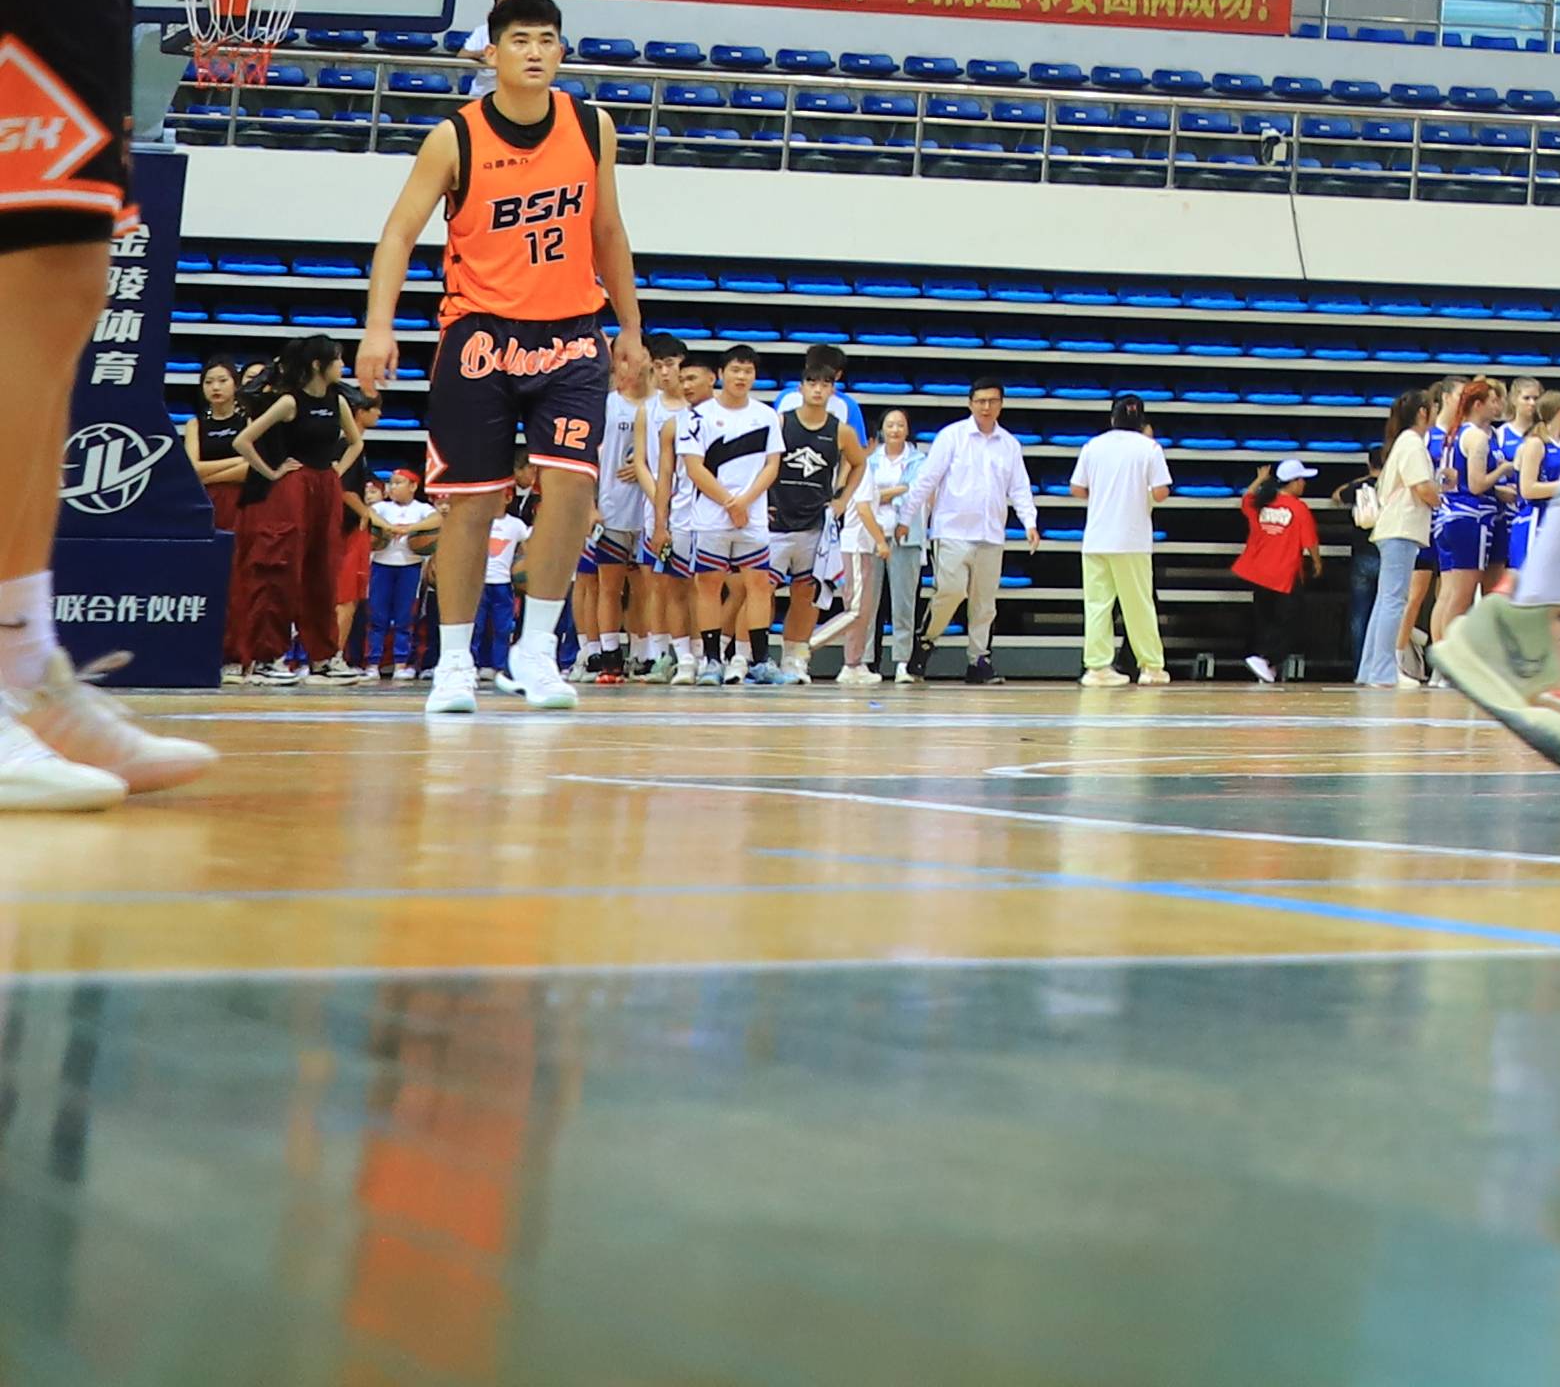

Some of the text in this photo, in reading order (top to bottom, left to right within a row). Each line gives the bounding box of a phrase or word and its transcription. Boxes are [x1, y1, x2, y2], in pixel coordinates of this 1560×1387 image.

[0, 116, 69, 153] SK
[488, 181, 587, 232] BSK
[523, 225, 566, 267] 12
[90, 223, 150, 385] 金陵体育
[552, 417, 590, 449] 12
[51, 595, 207, 623] 联合作伙伴
